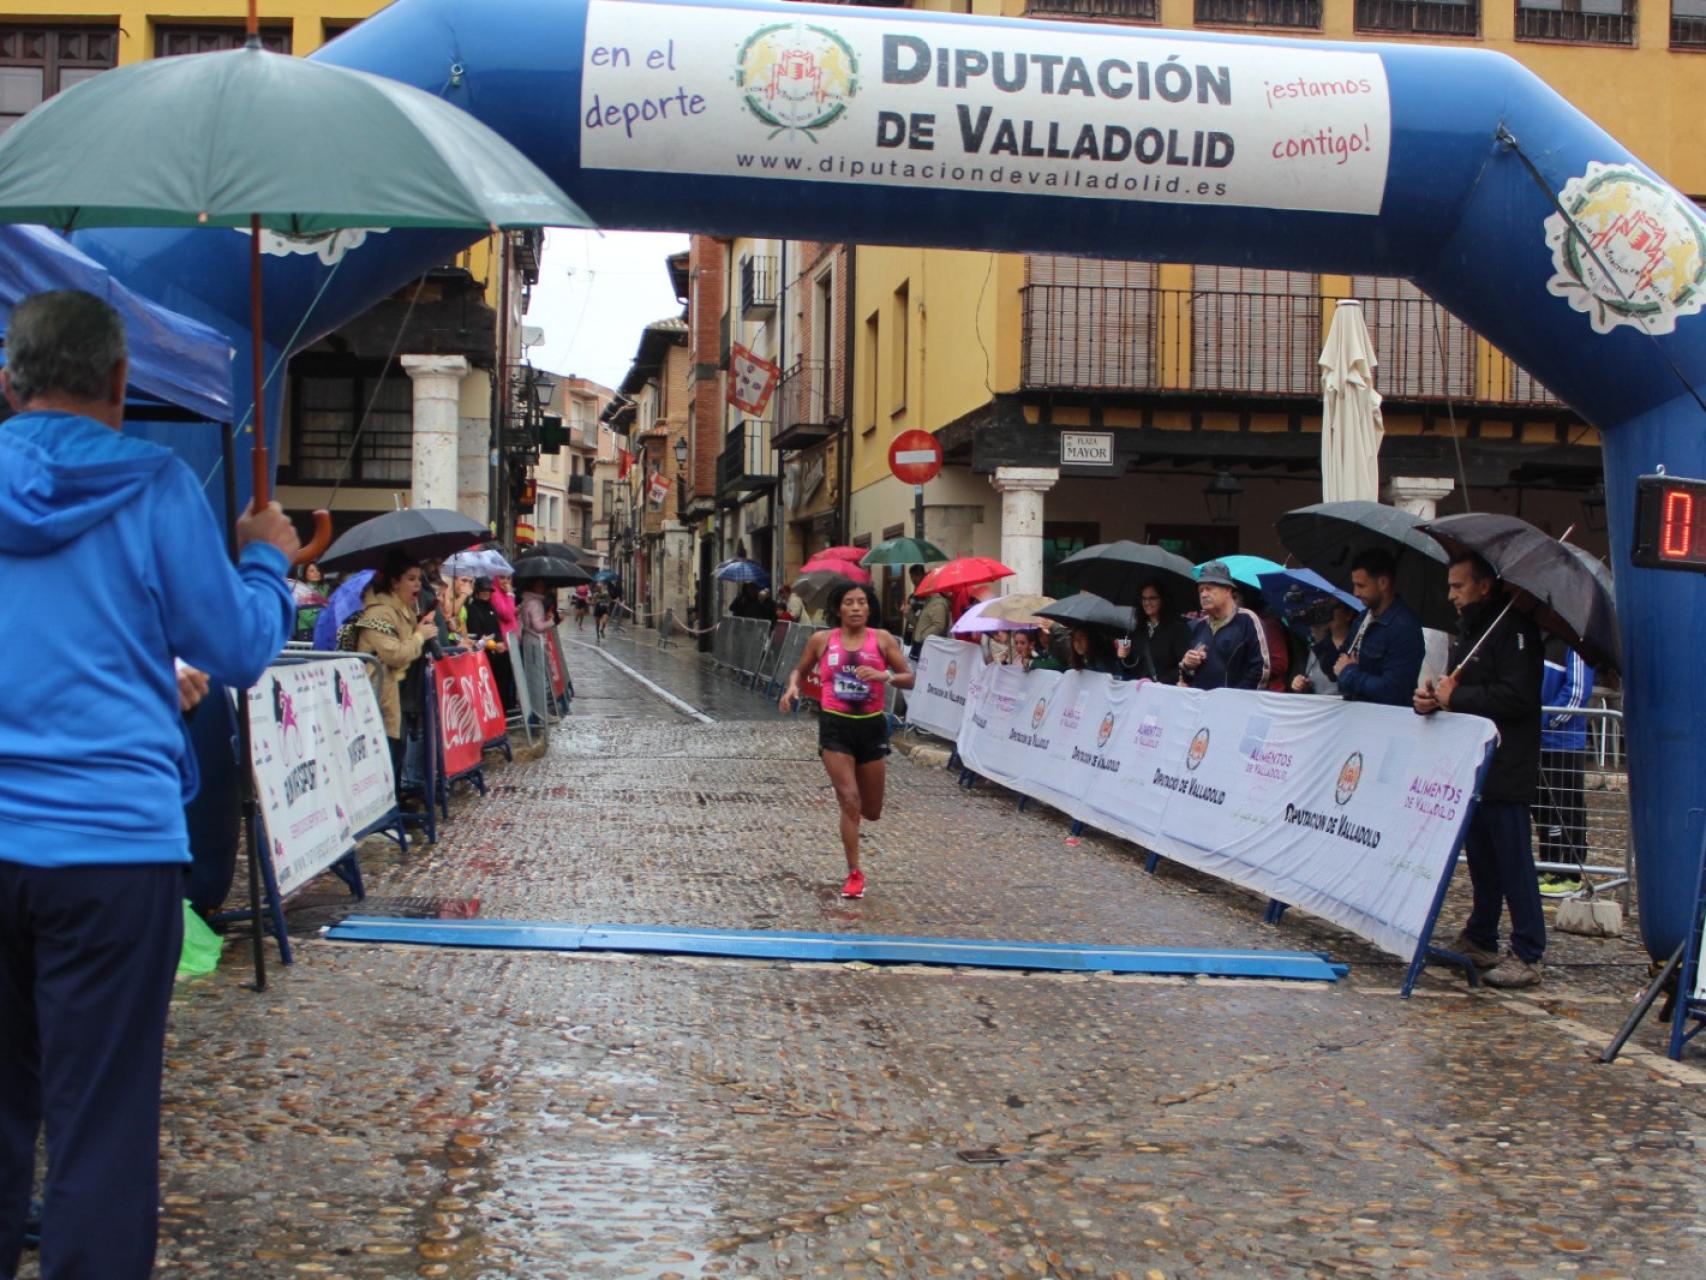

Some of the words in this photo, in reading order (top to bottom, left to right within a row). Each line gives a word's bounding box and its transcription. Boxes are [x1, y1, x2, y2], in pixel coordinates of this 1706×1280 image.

[591, 44, 631, 67] en
[646, 40, 675, 71] el
[882, 33, 1232, 105] DIPUTACIÓN
[1265, 77, 1372, 109] ¡estamos
[585, 87, 707, 140] deporte
[876, 110, 935, 151] DE
[956, 104, 1235, 169] VALLADOLID
[1272, 124, 1371, 165] contigo!
[736, 153, 1227, 197] www.diputaciondevalladolid.es
[1068, 447, 1107, 459] MAYOR
[1409, 775, 1463, 804] ALIMENTOS
[1327, 816, 1338, 834] DE
[1337, 813, 1381, 849] VALLADOLID
